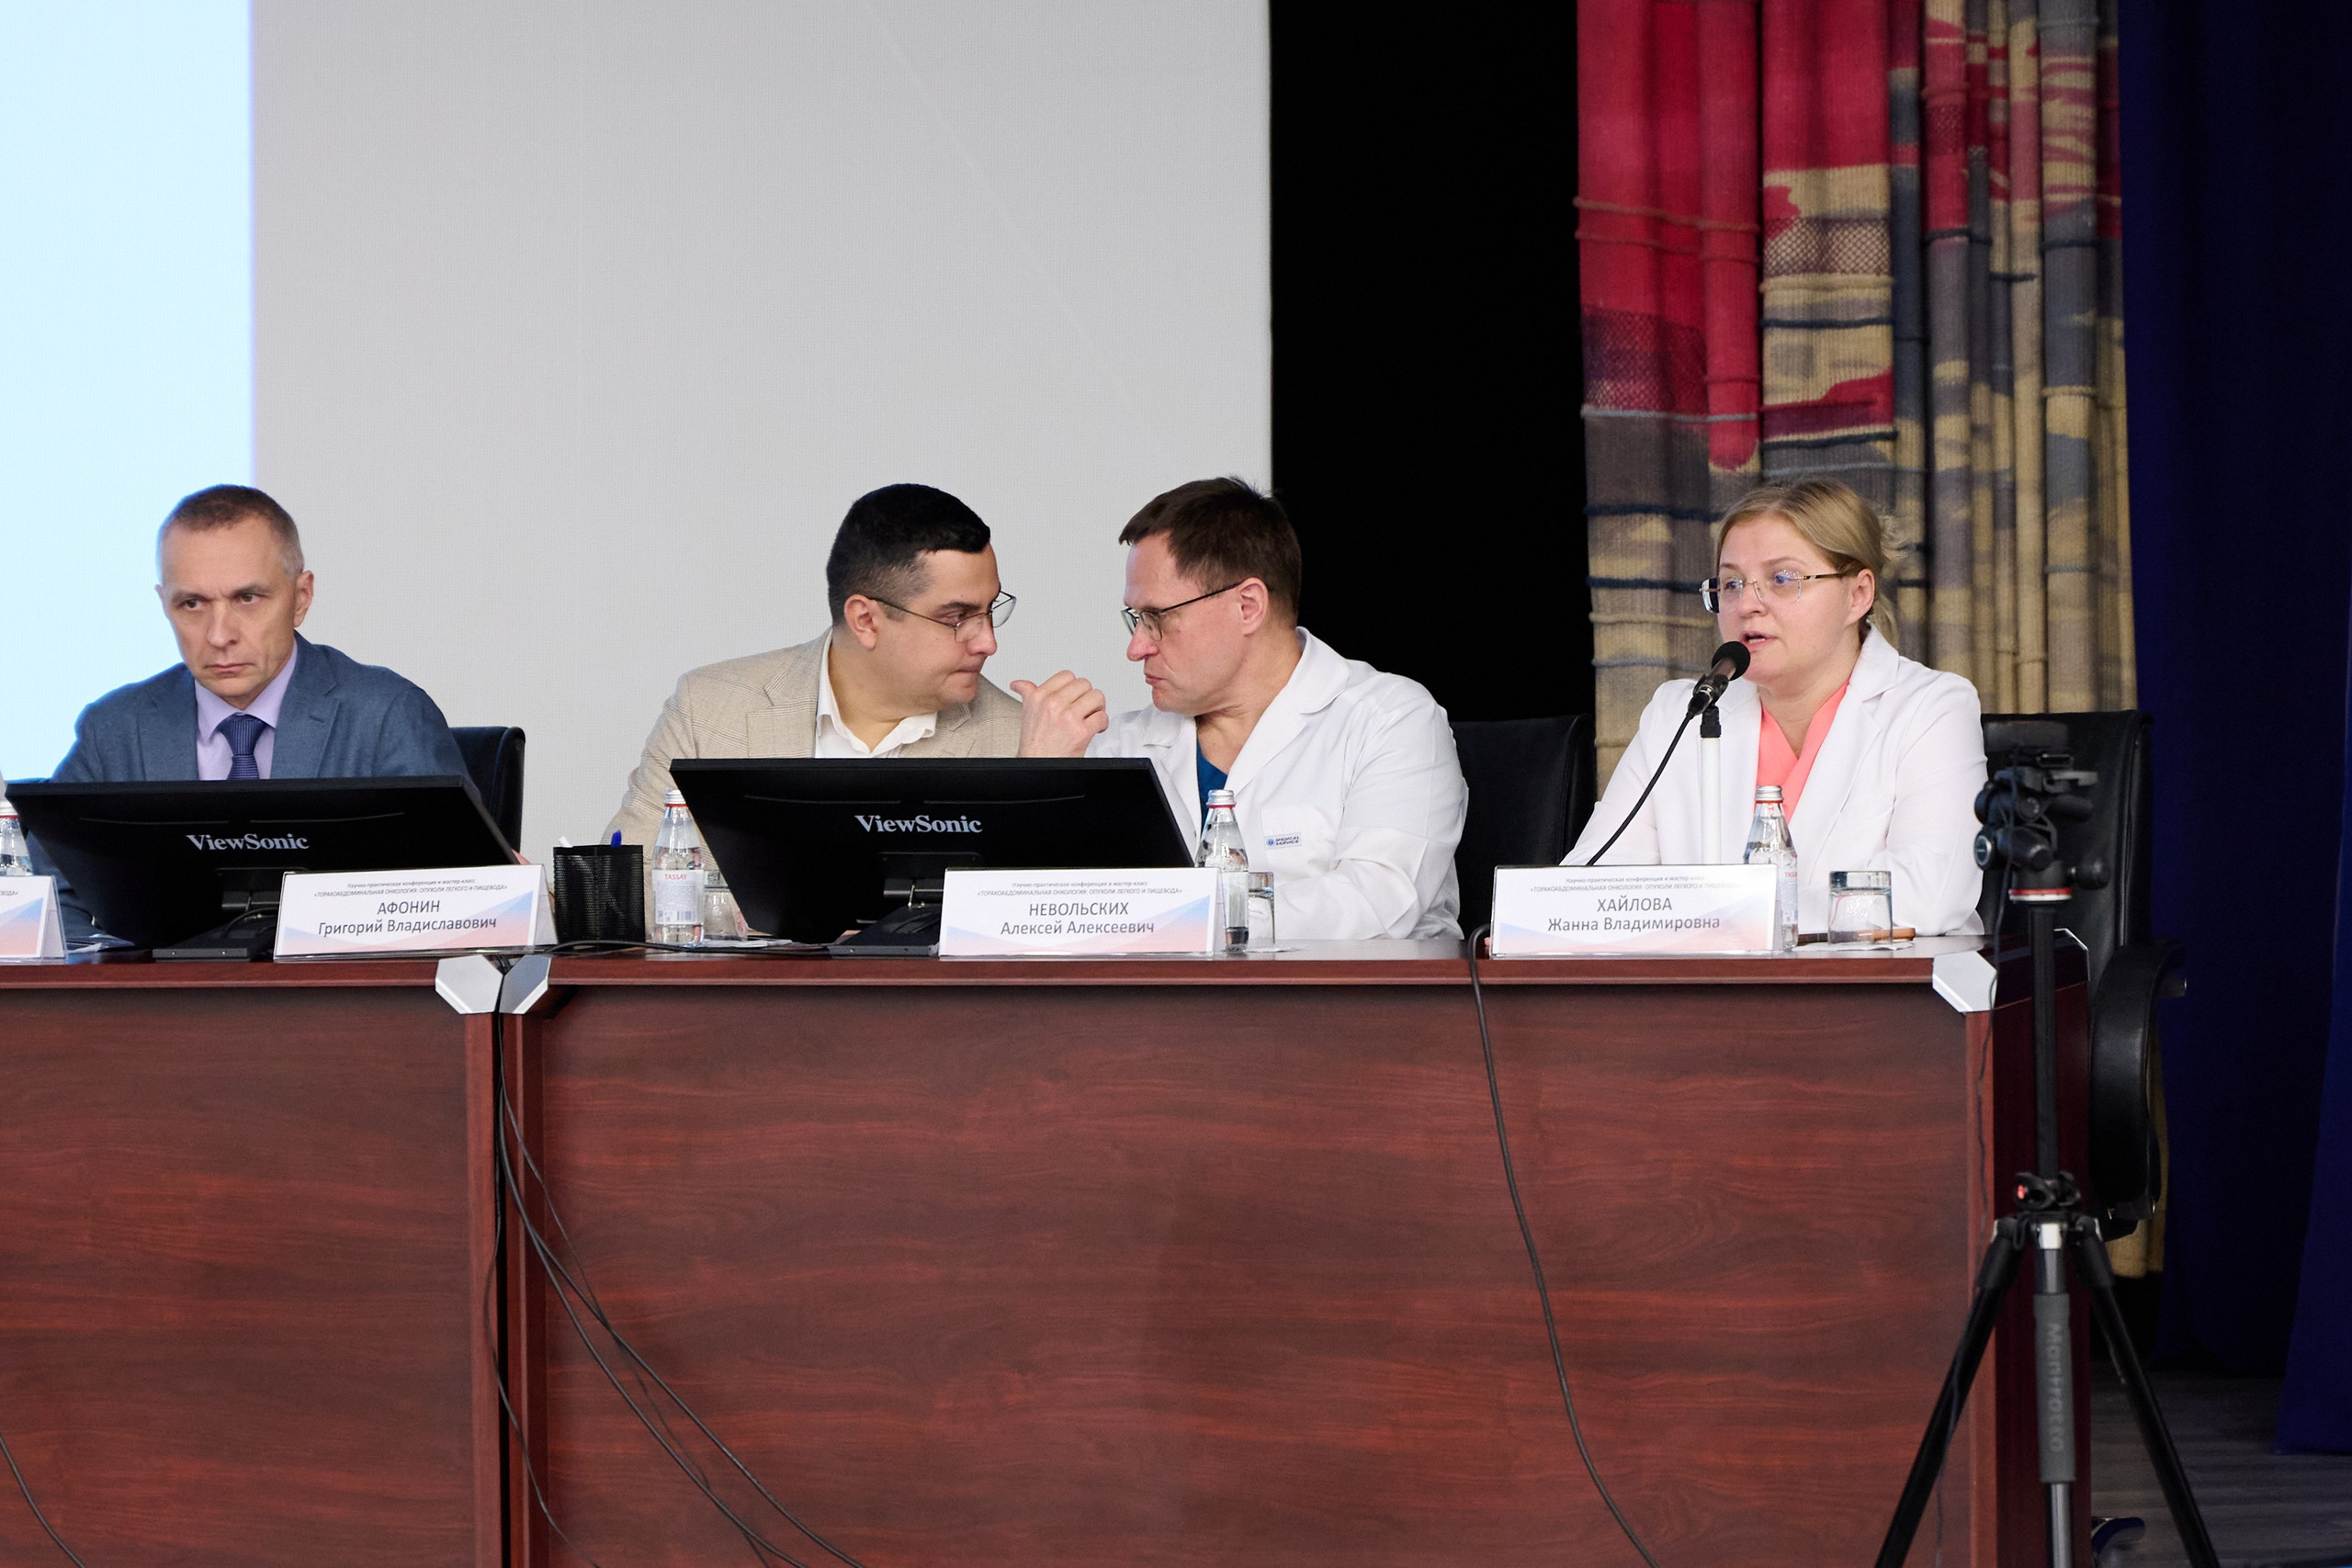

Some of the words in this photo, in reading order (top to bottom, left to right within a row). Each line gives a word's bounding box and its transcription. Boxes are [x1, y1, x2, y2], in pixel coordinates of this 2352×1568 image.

[854, 815, 983, 833] ViewSonic
[186, 833, 310, 851] ViewSonic
[377, 900, 440, 915] АФОНИН
[1029, 902, 1129, 916] НЕВОЛЬСКИХ
[1597, 895, 1672, 912] ХАЙЛОВА
[318, 919, 383, 937] Григорий
[387, 919, 497, 933] Владиславович
[1000, 919, 1062, 935] Алексей
[1067, 920, 1155, 933] Алексеевич
[1547, 918, 1599, 931] Жанна
[1604, 917, 1720, 932] Владимировна
[2047, 1323, 2064, 1452] Manfrotto
